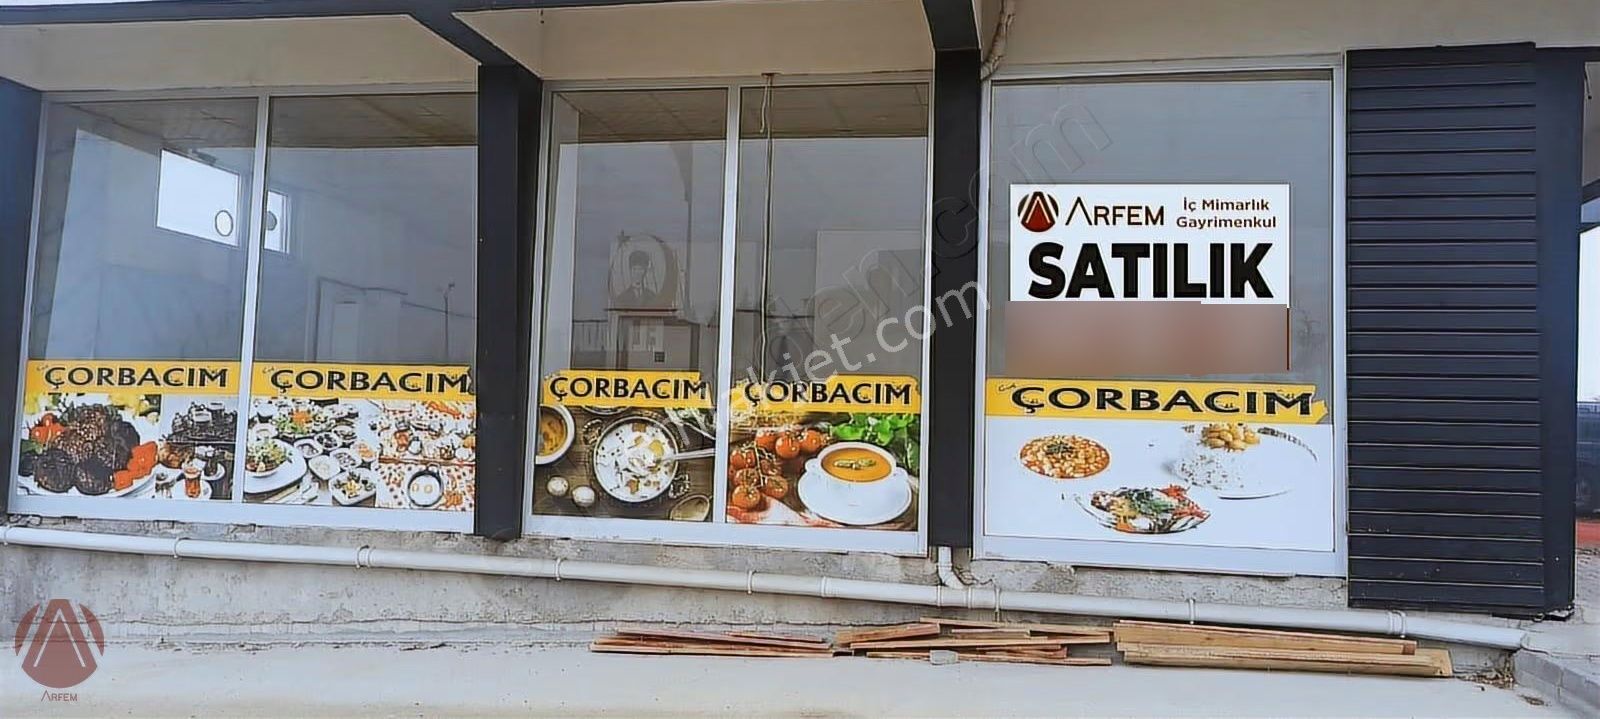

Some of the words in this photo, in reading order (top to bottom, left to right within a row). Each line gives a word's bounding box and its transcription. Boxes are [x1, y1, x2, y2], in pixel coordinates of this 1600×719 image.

[1065, 196, 1165, 226] ARFEM
[1183, 197, 1197, 212] İç
[1202, 197, 1270, 211] Mimarlık
[1176, 216, 1277, 230] Gayrimenkul
[1028, 242, 1274, 299] SATILIK
[44, 367, 228, 389] ÇORBACIM
[270, 369, 468, 393] ÇORBACIM
[550, 377, 707, 401] ÇORBACIM
[744, 381, 912, 406] ÇORBACIM
[1011, 387, 1313, 414] ÇORBACIM
